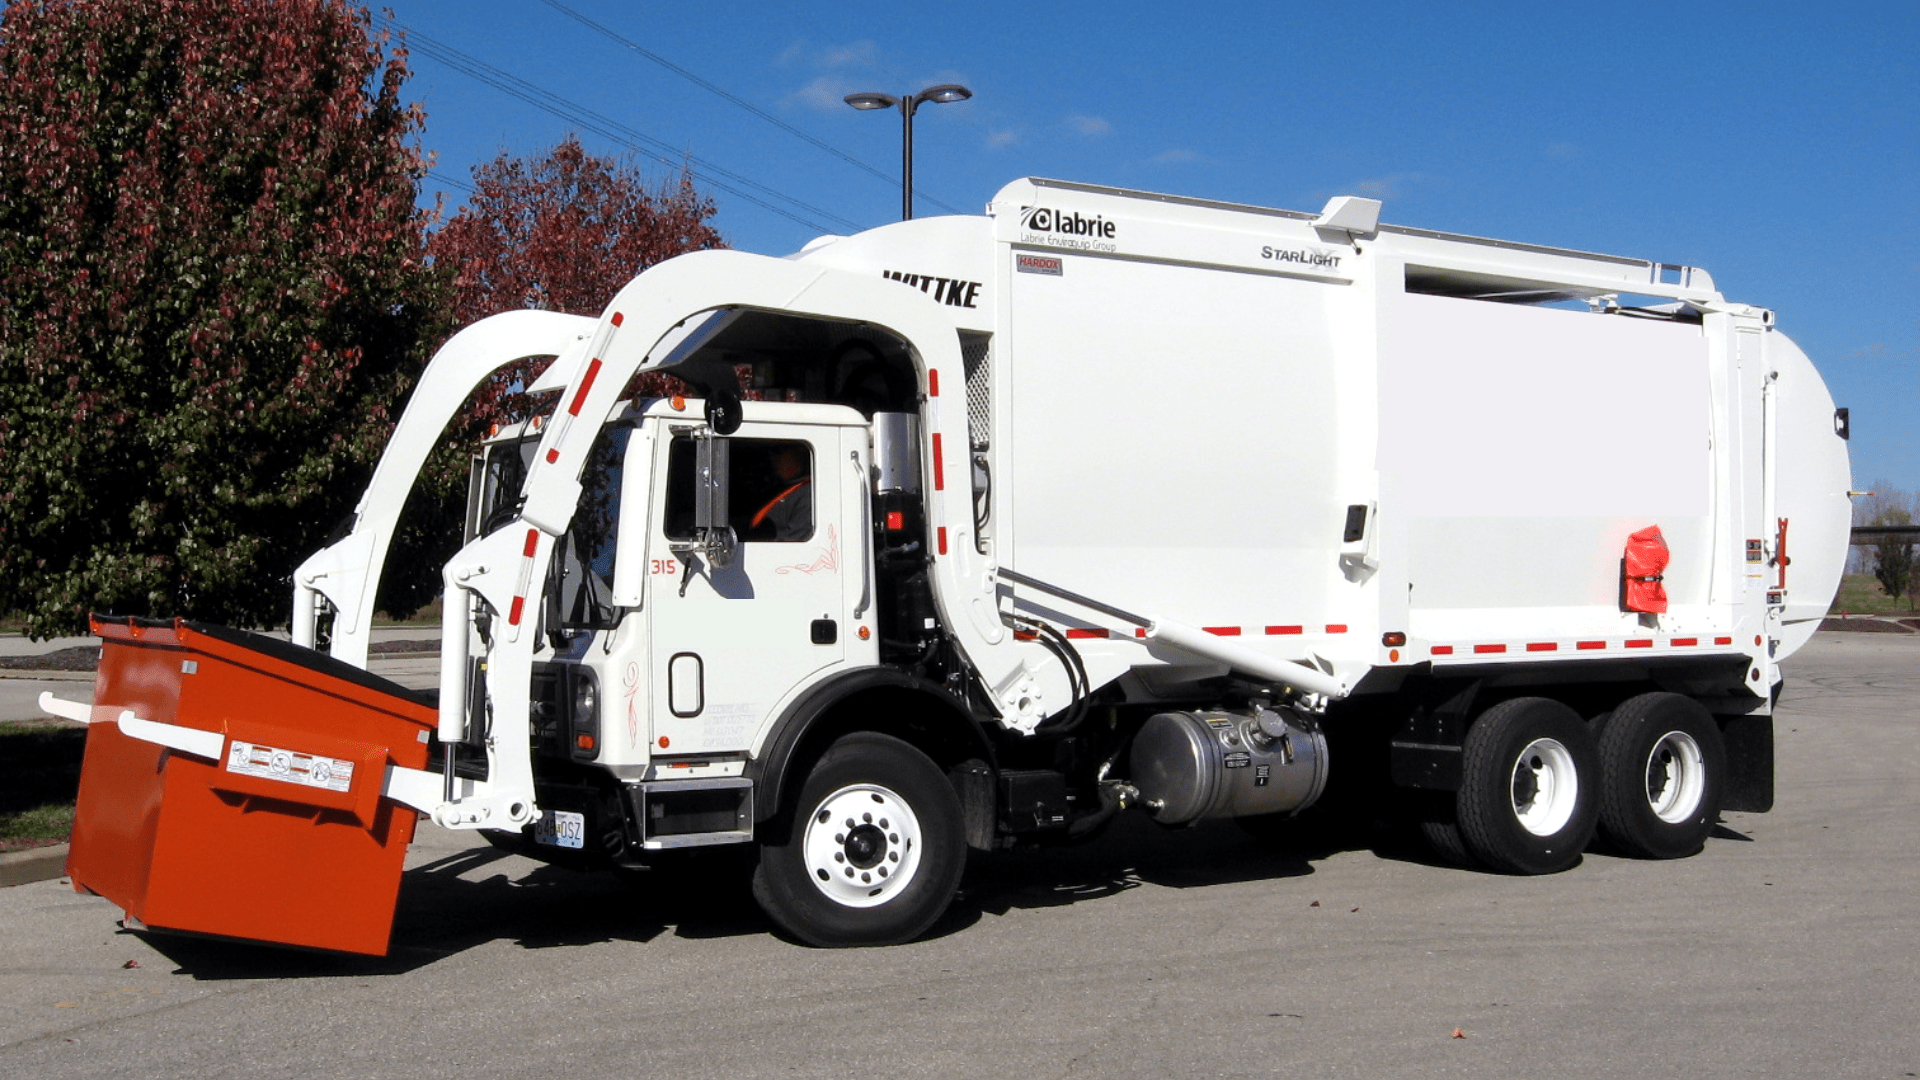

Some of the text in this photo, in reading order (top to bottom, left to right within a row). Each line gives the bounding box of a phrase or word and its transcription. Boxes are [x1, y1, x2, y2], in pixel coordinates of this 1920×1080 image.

[1055, 209, 1116, 239] labrie
[1020, 232, 1045, 245] Labrie
[1092, 240, 1116, 253] Group
[1019, 256, 1060, 270] HARDOX
[882, 269, 983, 309] TTKE
[651, 559, 676, 574] 315
